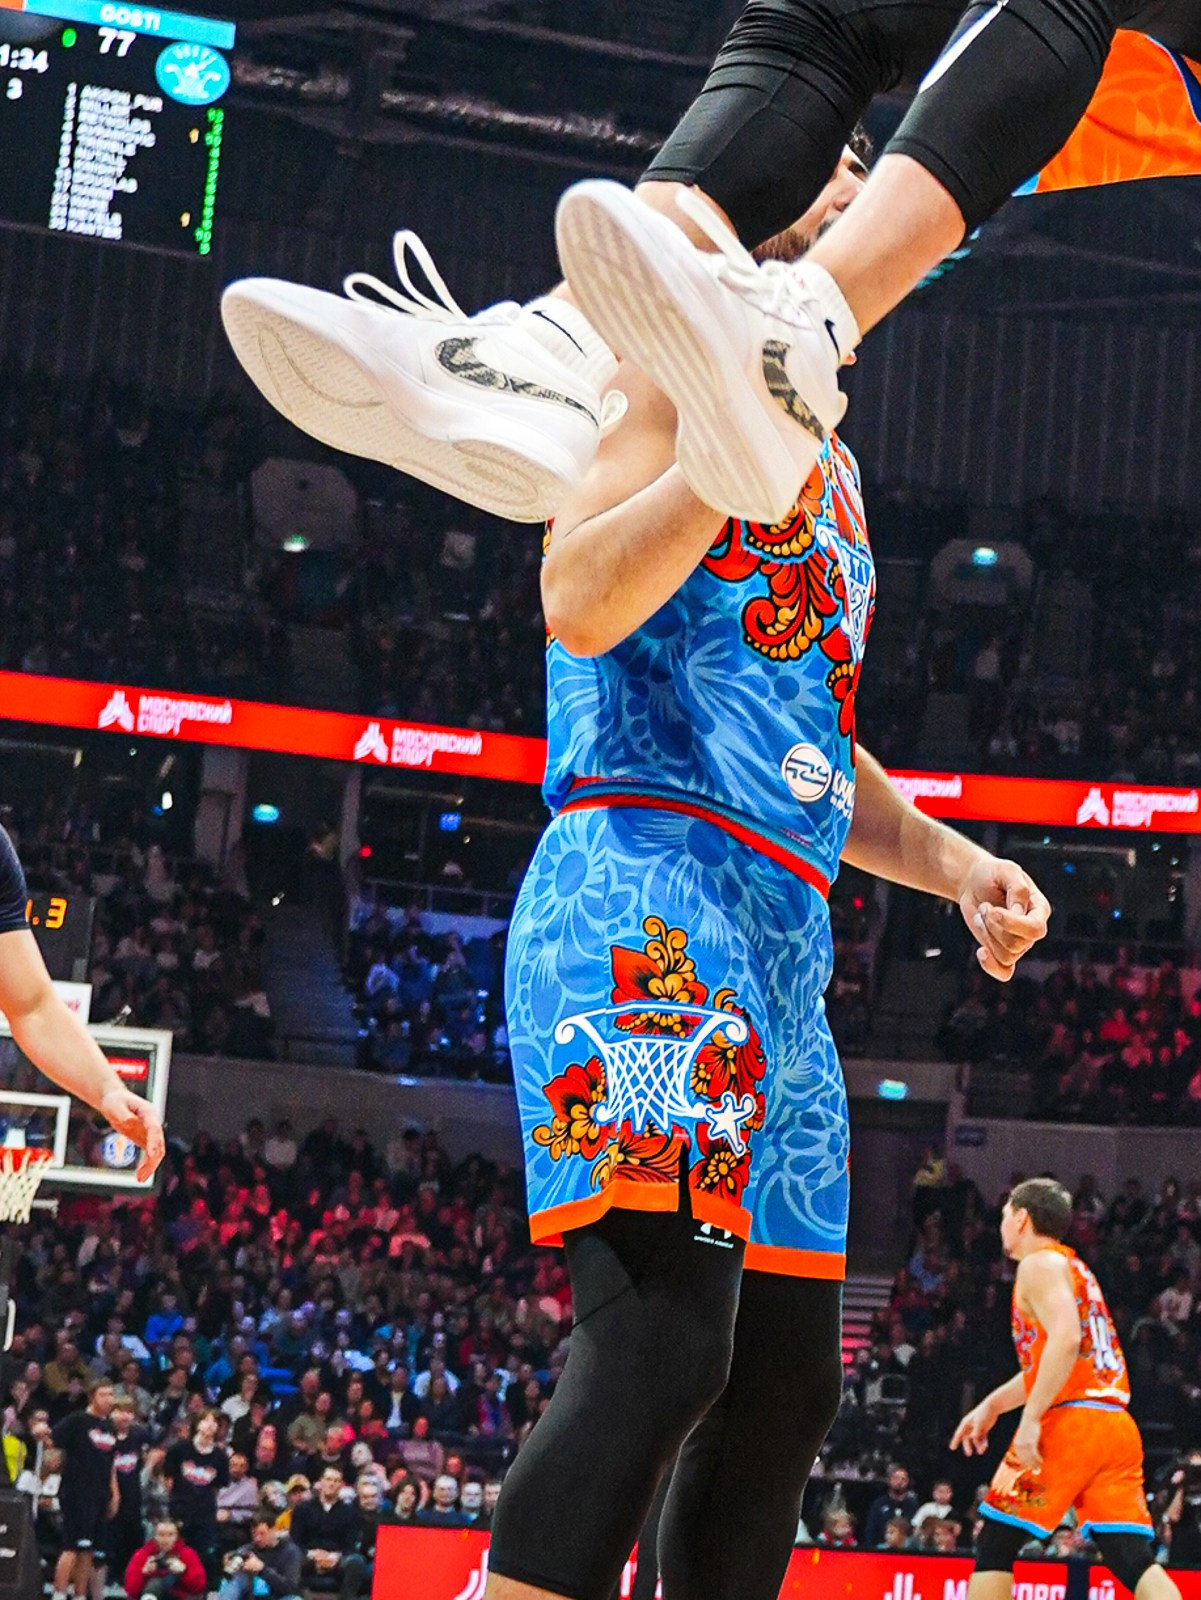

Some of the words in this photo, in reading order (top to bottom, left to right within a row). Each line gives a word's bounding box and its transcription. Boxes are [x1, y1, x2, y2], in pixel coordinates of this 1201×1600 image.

[98, 26, 137, 57] 77
[139, 694, 232, 725] МОСКОВСКИЙ
[393, 726, 482, 757] МОСКОВСКИЙ
